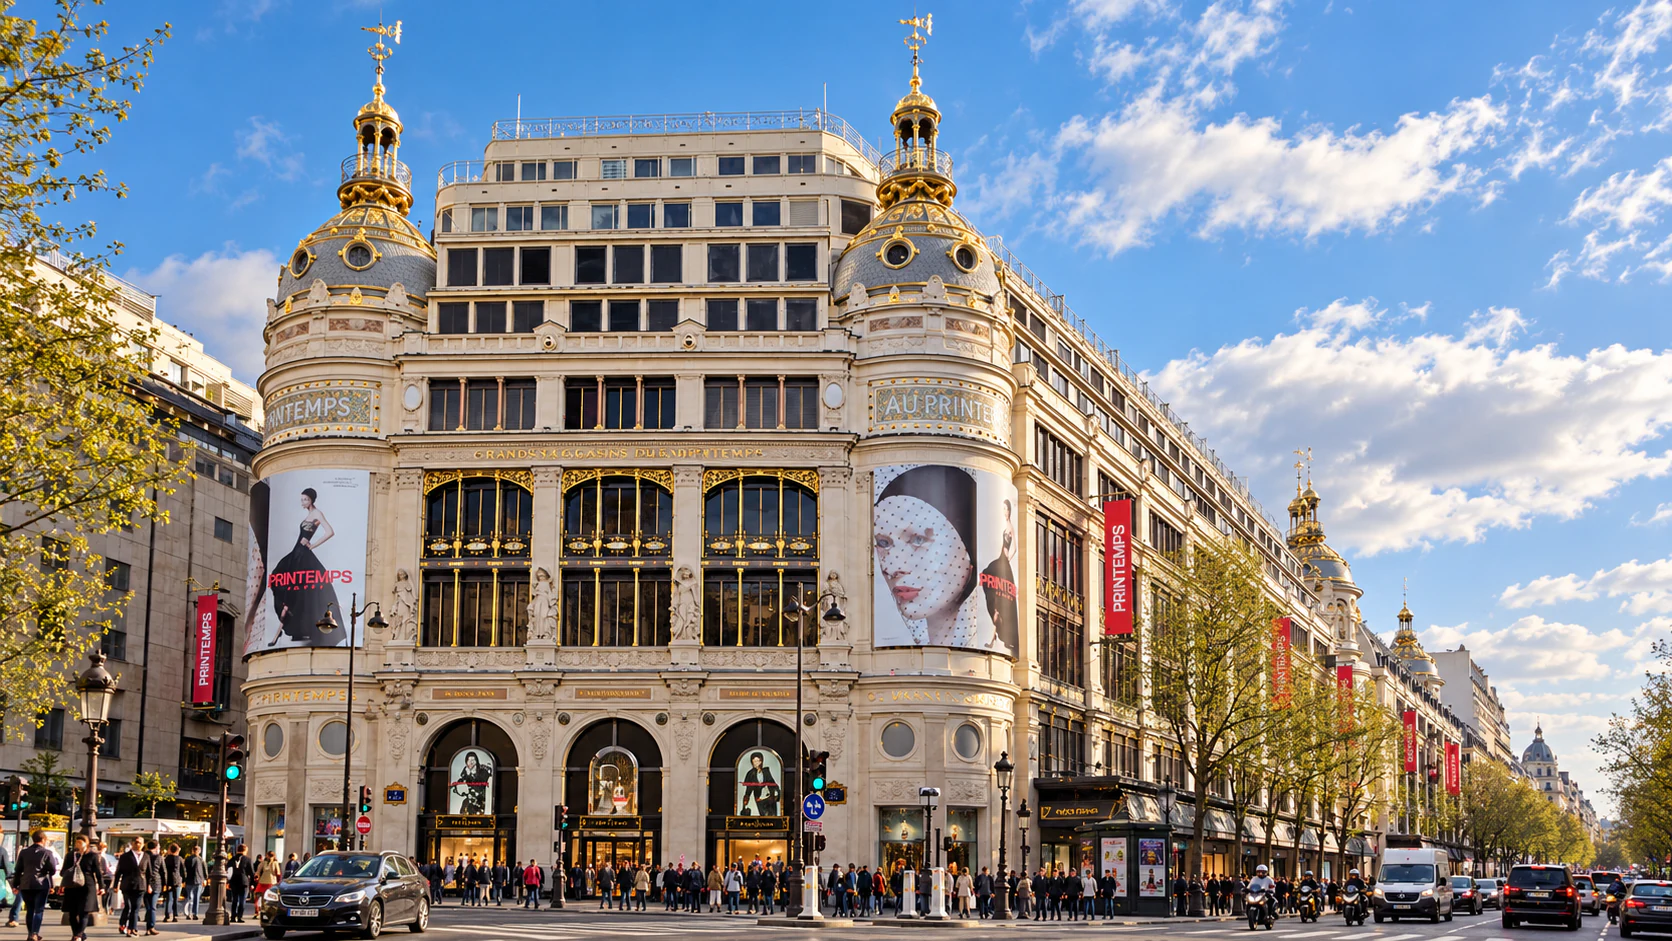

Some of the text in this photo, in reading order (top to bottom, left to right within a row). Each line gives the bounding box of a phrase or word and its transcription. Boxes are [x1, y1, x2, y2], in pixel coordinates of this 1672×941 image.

[885, 394, 917, 416] AU
[267, 569, 353, 589] PRINTEMPS
[1112, 524, 1127, 613] PRINTEMPS
[198, 611, 213, 687] PRINTEMPS
